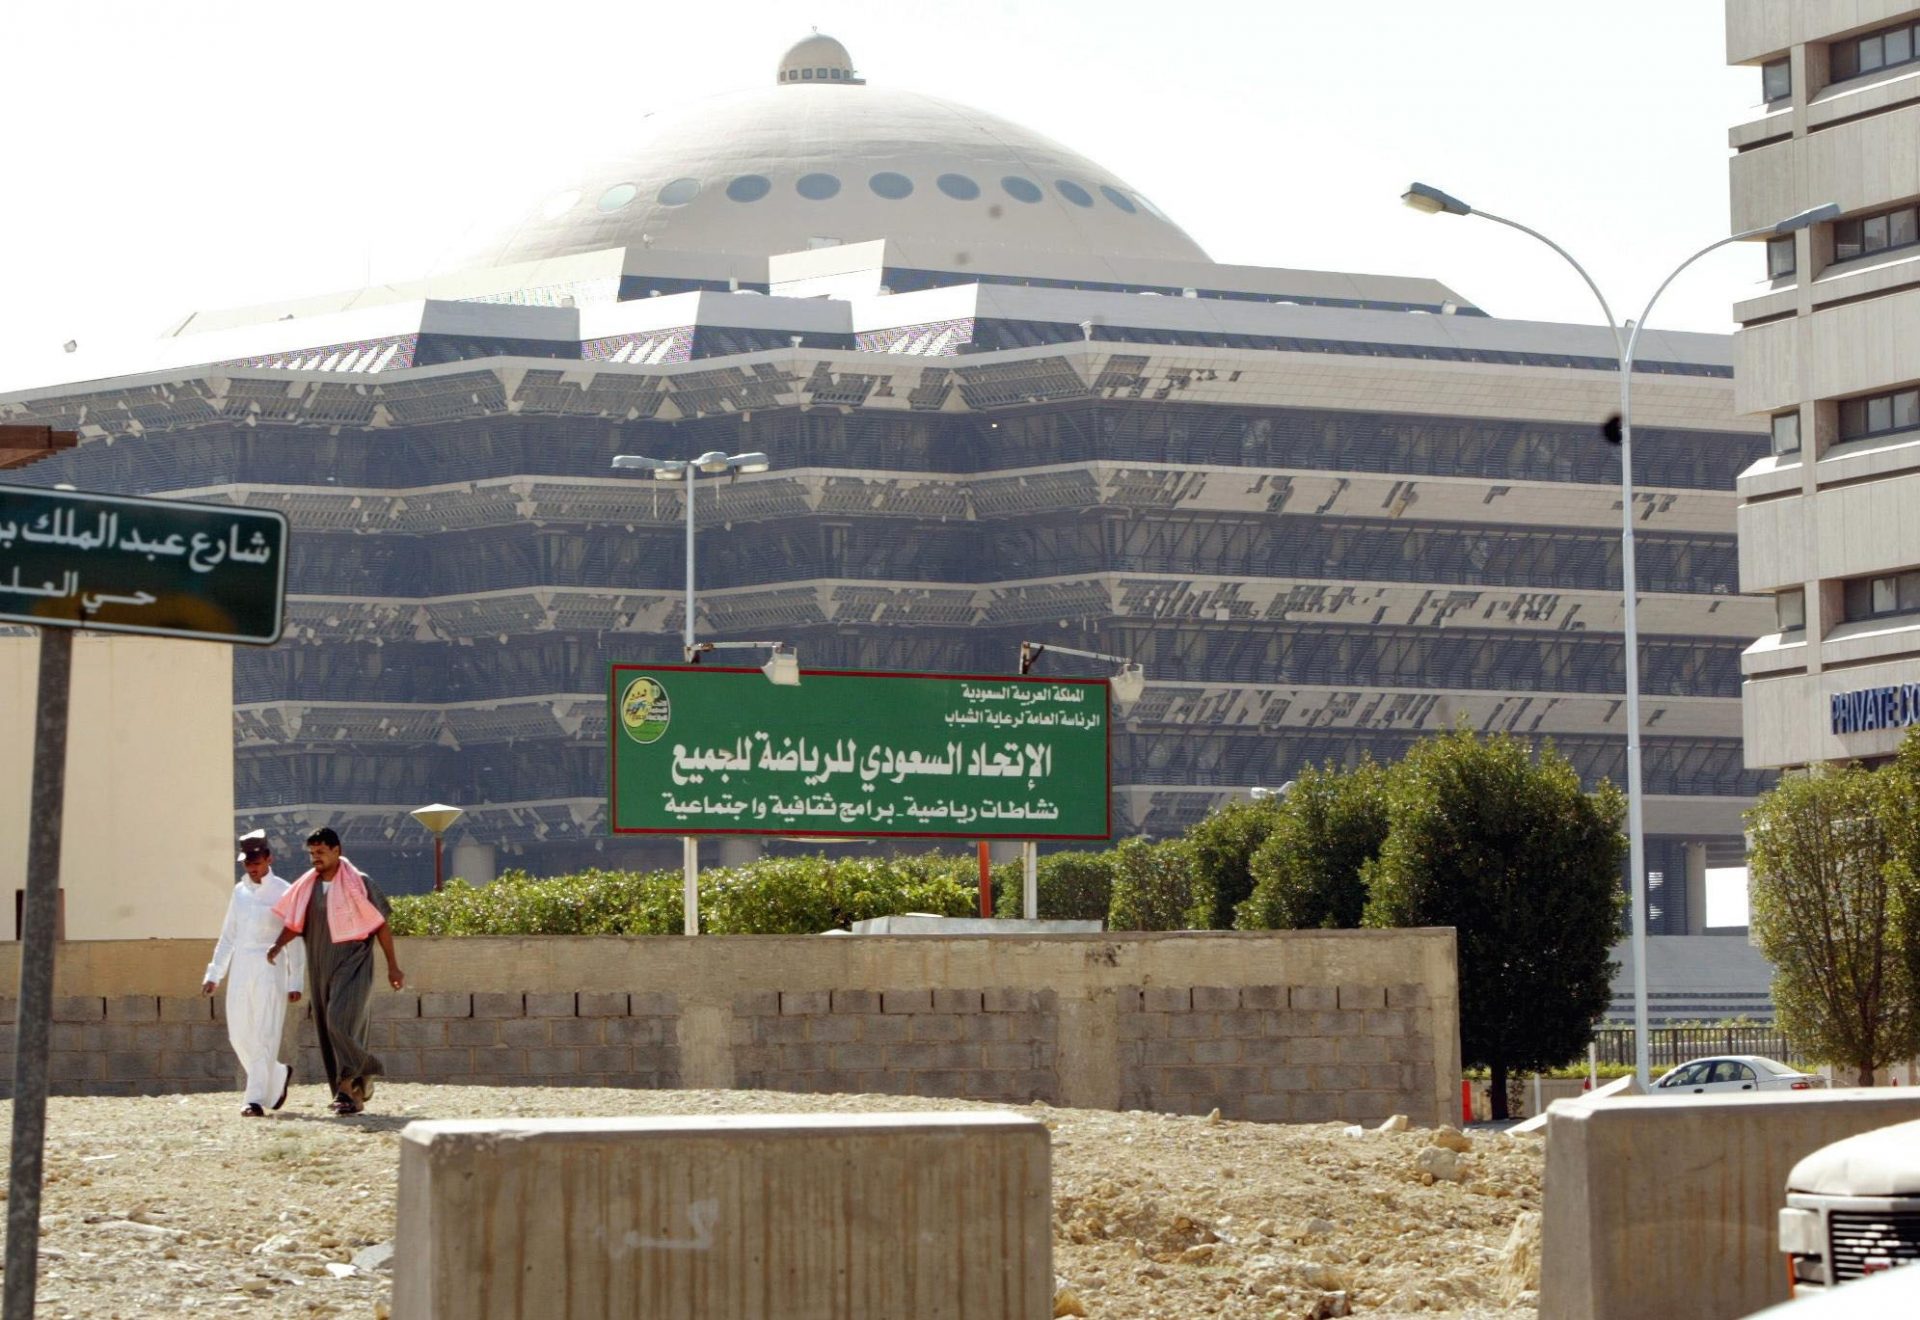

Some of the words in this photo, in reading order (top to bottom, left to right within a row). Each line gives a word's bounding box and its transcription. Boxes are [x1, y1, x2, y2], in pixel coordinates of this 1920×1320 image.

[0, 520, 18, 549] ب
[21, 507, 118, 549] الملك
[119, 527, 187, 561] عبد
[188, 523, 271, 573] شارع
[0, 565, 79, 597] العل
[81, 590, 157, 614] حي
[961, 683, 1010, 703] السعودية
[1011, 685, 1051, 706] العربية
[1052, 686, 1085, 702] المملكة
[944, 708, 984, 728] الشباب
[985, 708, 1025, 728] لرعاية
[1025, 710, 1059, 725] العامة
[1830, 686, 1899, 735] PRIVATE
[671, 735, 753, 786] للجميع
[754, 731, 857, 786] للرياضة
[859, 741, 963, 793] السعودي
[967, 741, 1052, 791] الإتحاد
[768, 792, 837, 823] ثقافية
[838, 799, 895, 825] برامج
[903, 795, 978, 825] رياضية
[980, 798, 1060, 820] نشاطات
